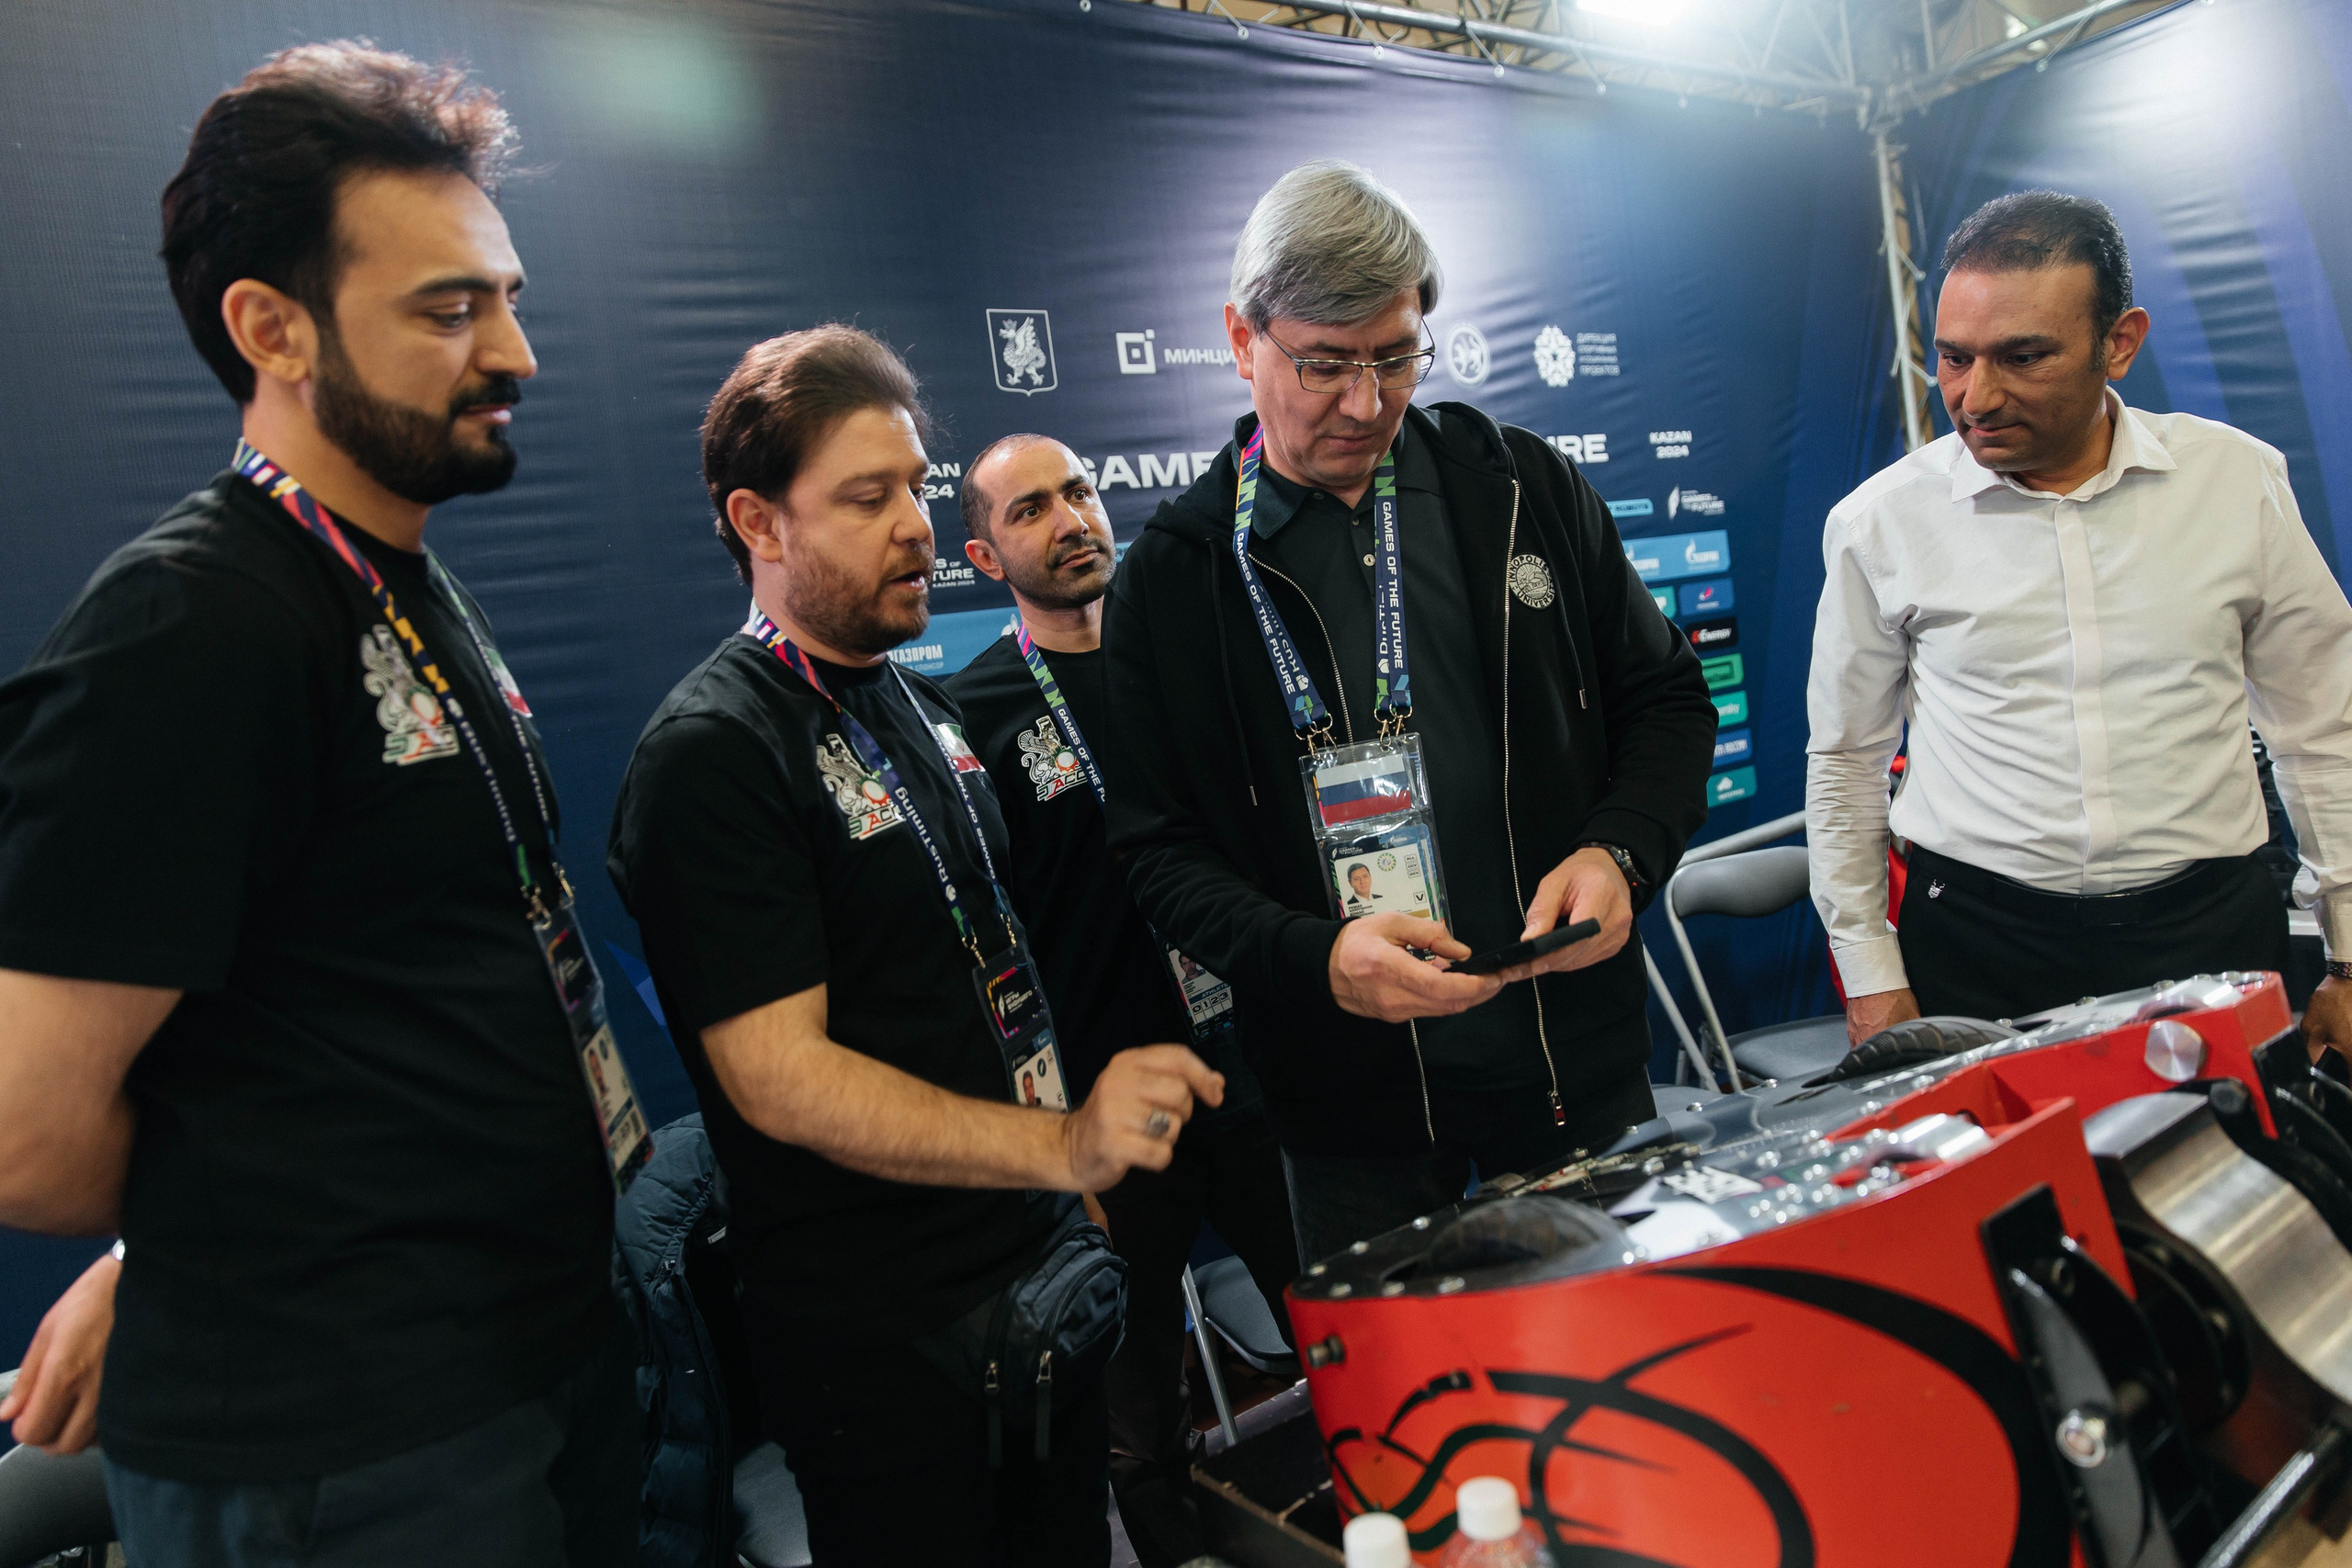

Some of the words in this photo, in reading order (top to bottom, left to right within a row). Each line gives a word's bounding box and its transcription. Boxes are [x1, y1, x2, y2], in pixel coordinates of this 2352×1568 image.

[1164, 348, 1237, 367] МИНЦИ
[1649, 431, 1692, 445] KAZAN
[1657, 445, 1690, 459] 2024
[924, 483, 955, 500] 24
[1383, 502, 1396, 553] GAMES
[949, 560, 962, 569] OF
[1387, 556, 1397, 576] OF
[1509, 555, 1549, 583] INNOPOLIS
[933, 568, 975, 581] TURE
[1388, 579, 1400, 608] THE
[1236, 532, 1252, 582] GAMES
[1250, 584, 1261, 604] OF
[1258, 605, 1273, 640] THE
[1269, 638, 1295, 694] FUTURE
[1391, 611, 1403, 670] FUTURE
[1057, 708, 1080, 745] GAMES
[1078, 747, 1090, 761] OF
[1086, 762, 1101, 785] THE
[955, 773, 969, 801] THE
[967, 804, 978, 823] OF
[894, 786, 949, 883] RusTiming
[977, 828, 996, 879] GAMES
[1415, 893, 1424, 901] V
[1202, 983, 1229, 998] ATHLETE
[1210, 997, 1219, 1005] 2
[1219, 992, 1228, 1000] 3
